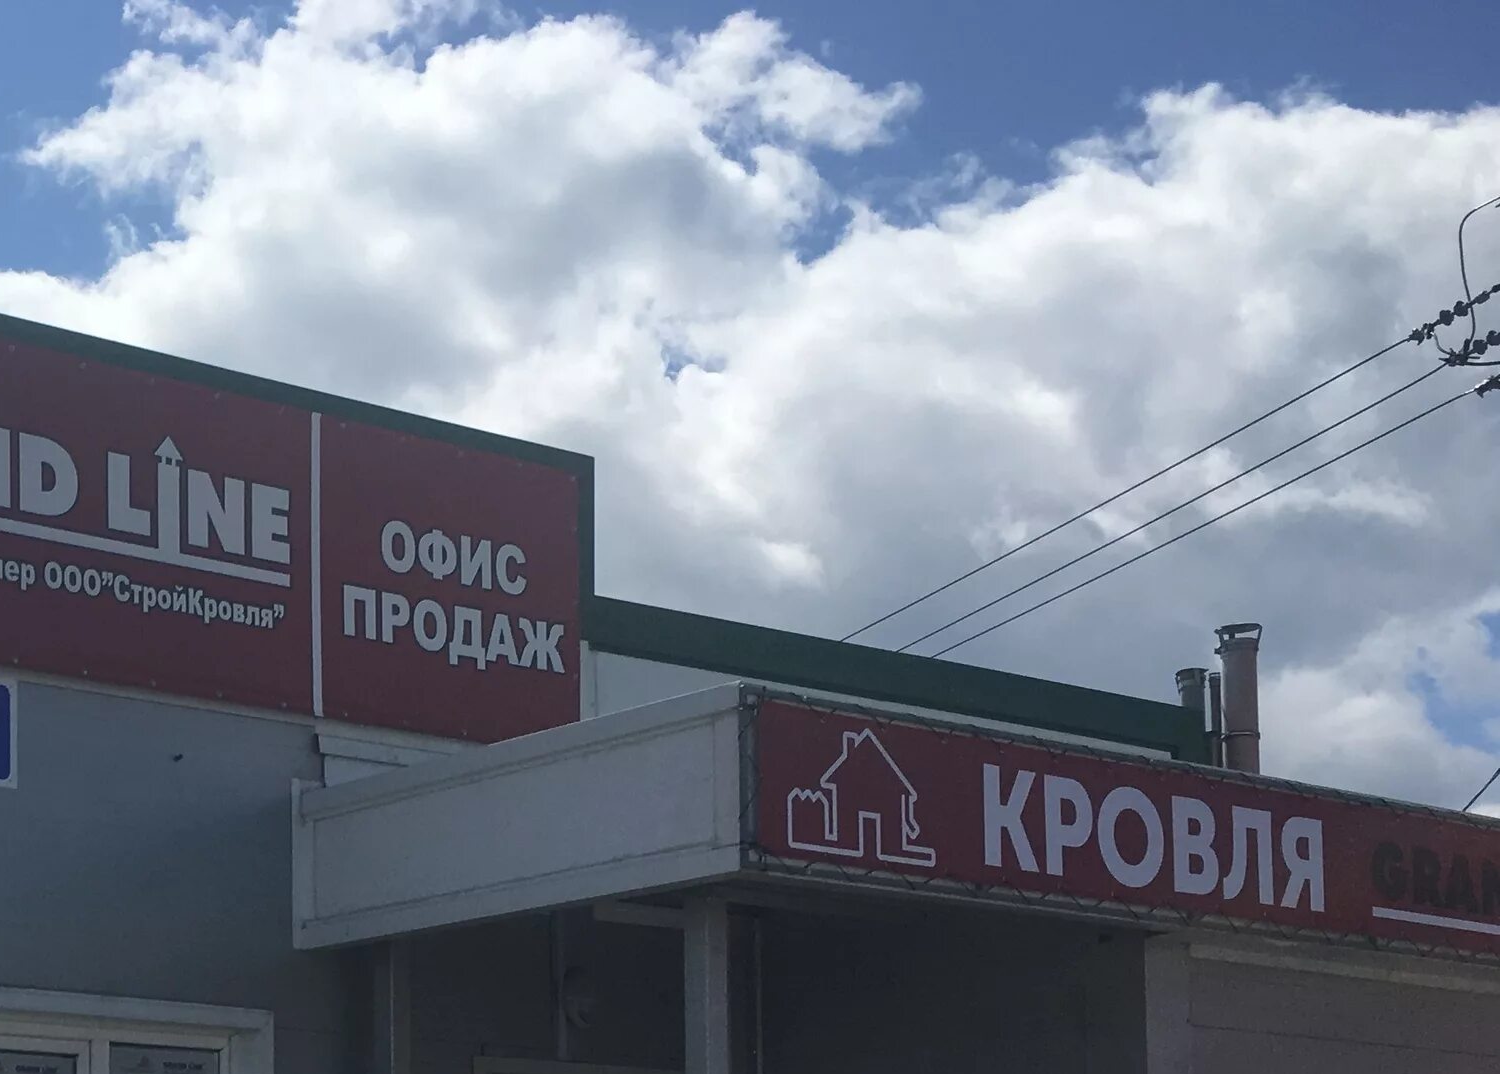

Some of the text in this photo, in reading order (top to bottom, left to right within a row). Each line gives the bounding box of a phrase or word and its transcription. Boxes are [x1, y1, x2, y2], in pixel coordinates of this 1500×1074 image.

[107, 437, 291, 565] LINE
[380, 519, 527, 596] ОФИС
[343, 584, 565, 674] ПРОДАЖ
[983, 763, 1325, 912] КРОВЛЯ
